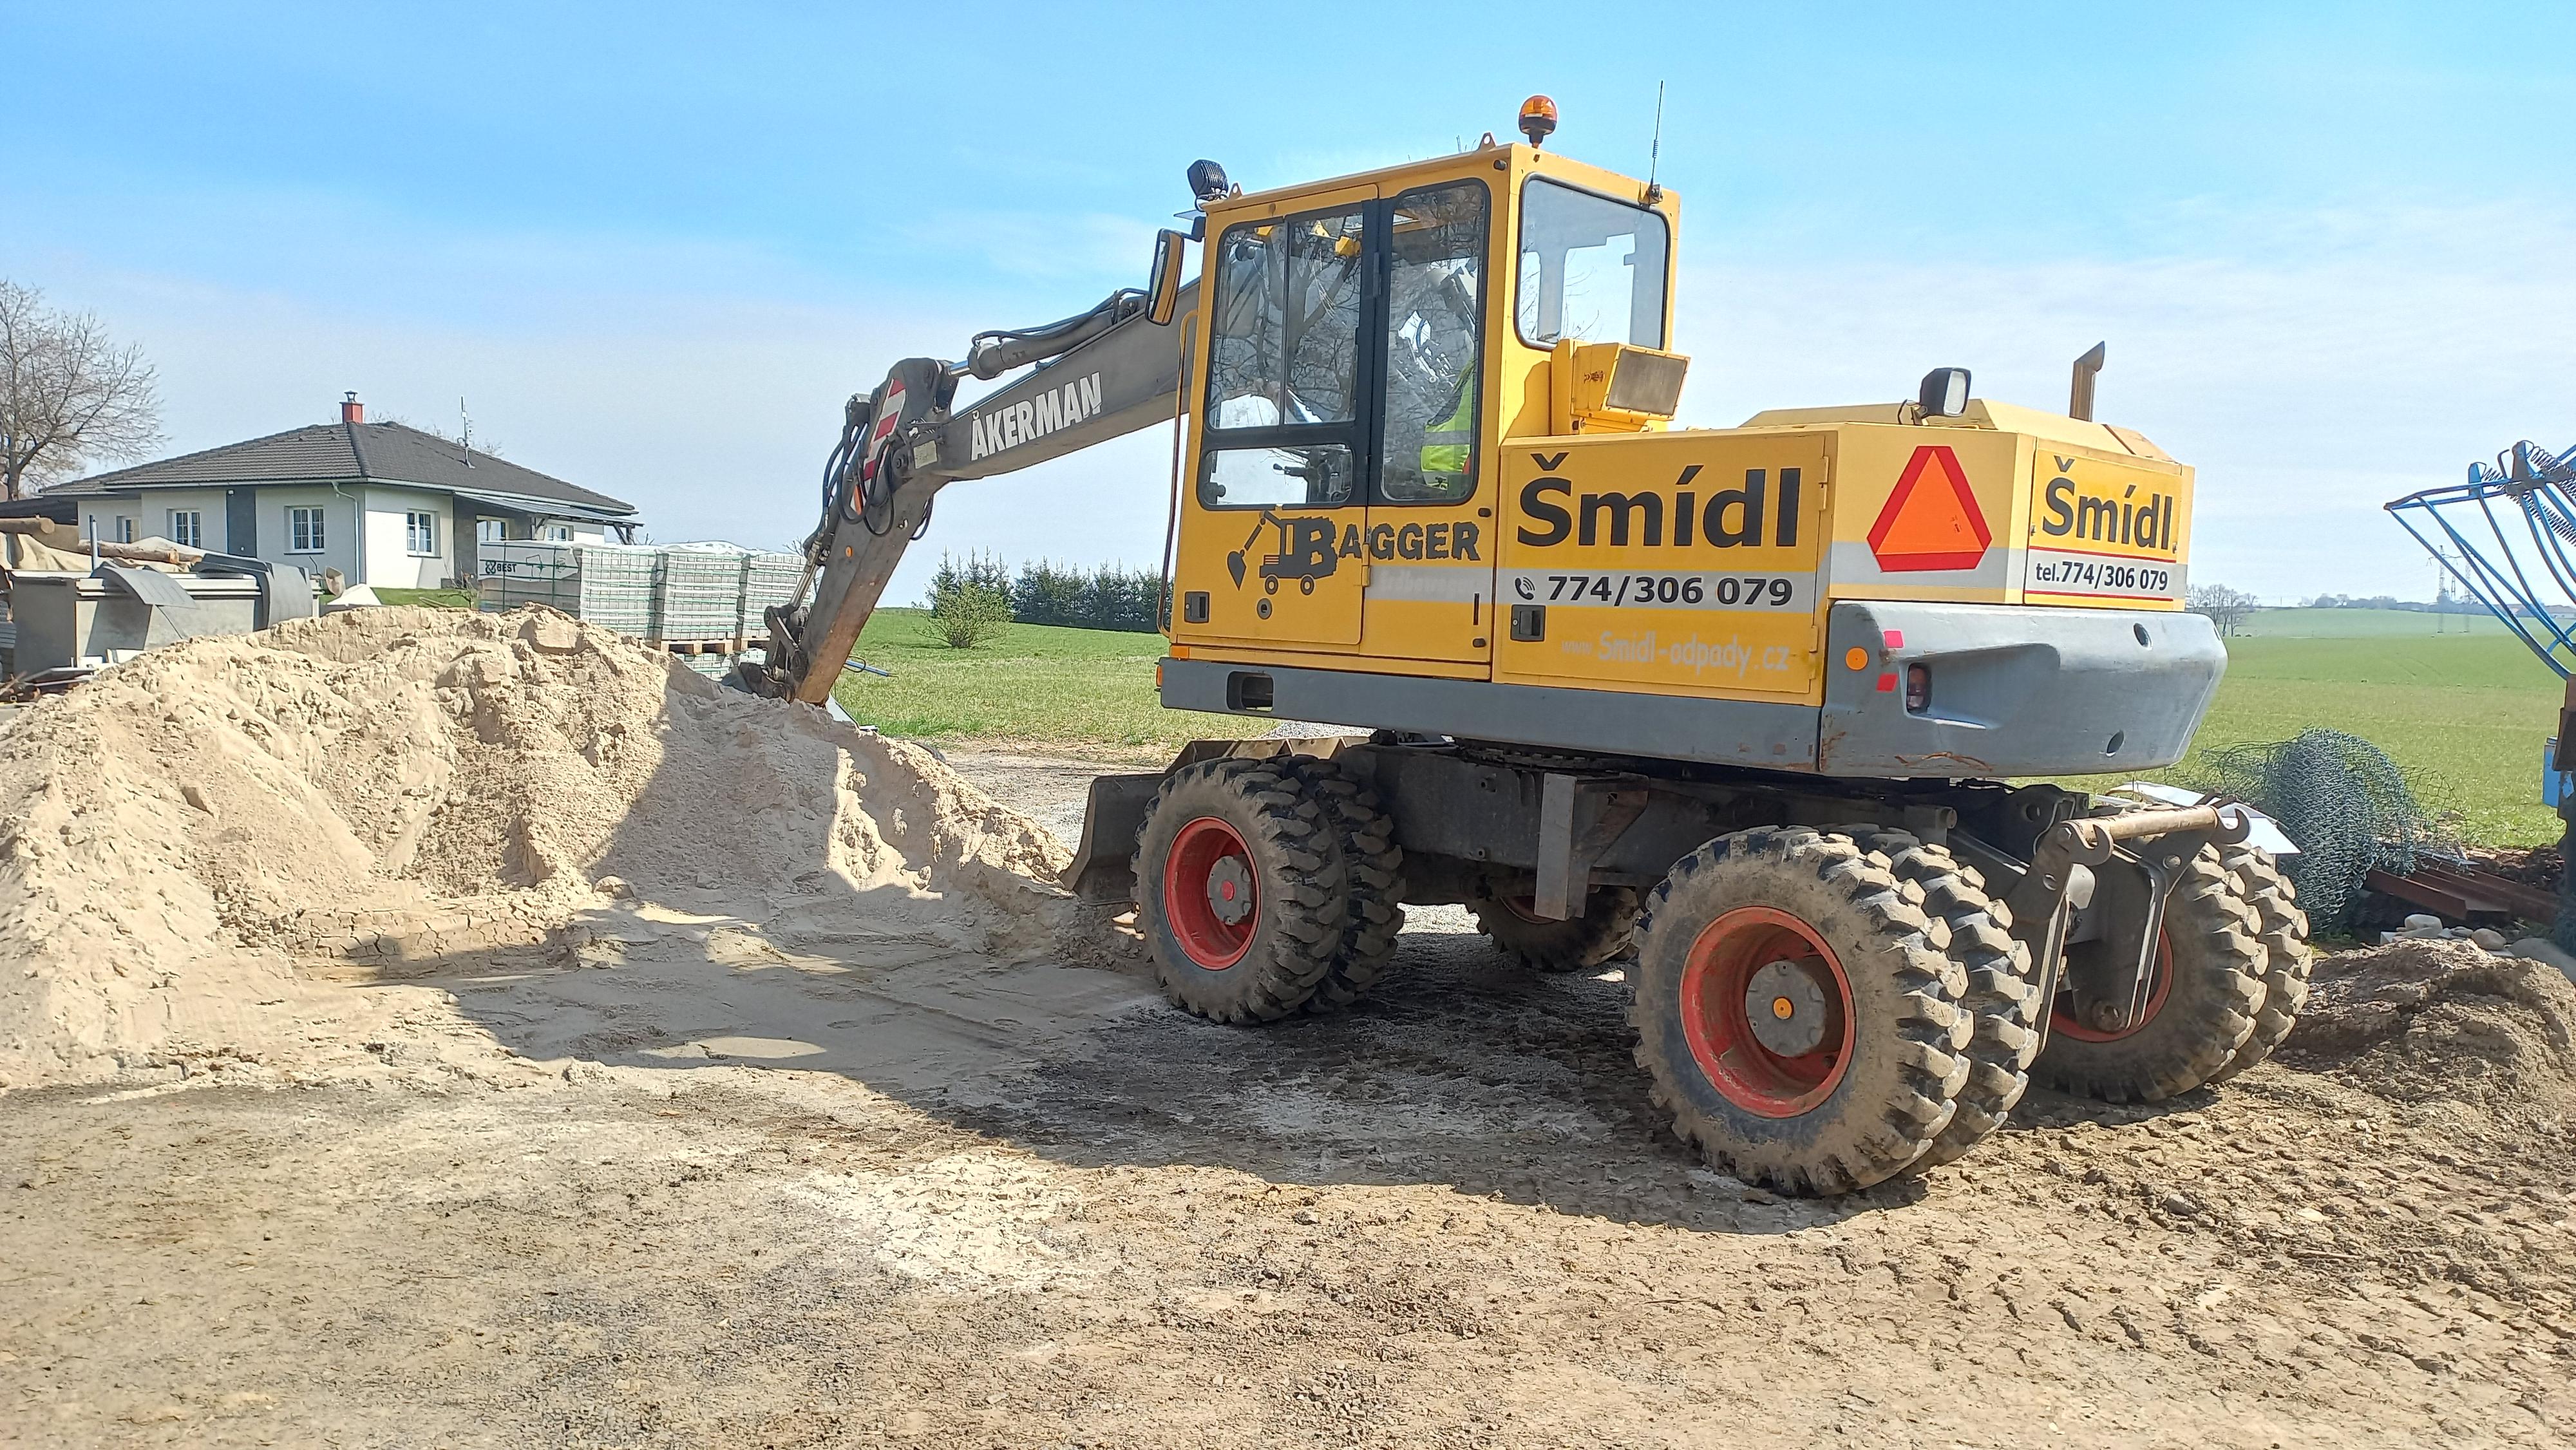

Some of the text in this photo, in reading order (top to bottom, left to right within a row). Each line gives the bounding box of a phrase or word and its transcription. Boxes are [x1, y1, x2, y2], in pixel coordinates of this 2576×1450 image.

[971, 372, 1103, 461] ÅKERMAN
[1517, 452, 1801, 548] Šmídl
[2042, 456, 2173, 551] Šmídl
[497, 563, 517, 572] BEST
[1294, 516, 1481, 579] BAGGER
[2036, 561, 2168, 591] tel.774/306 079
[1548, 576, 1793, 607] 774/306 079
